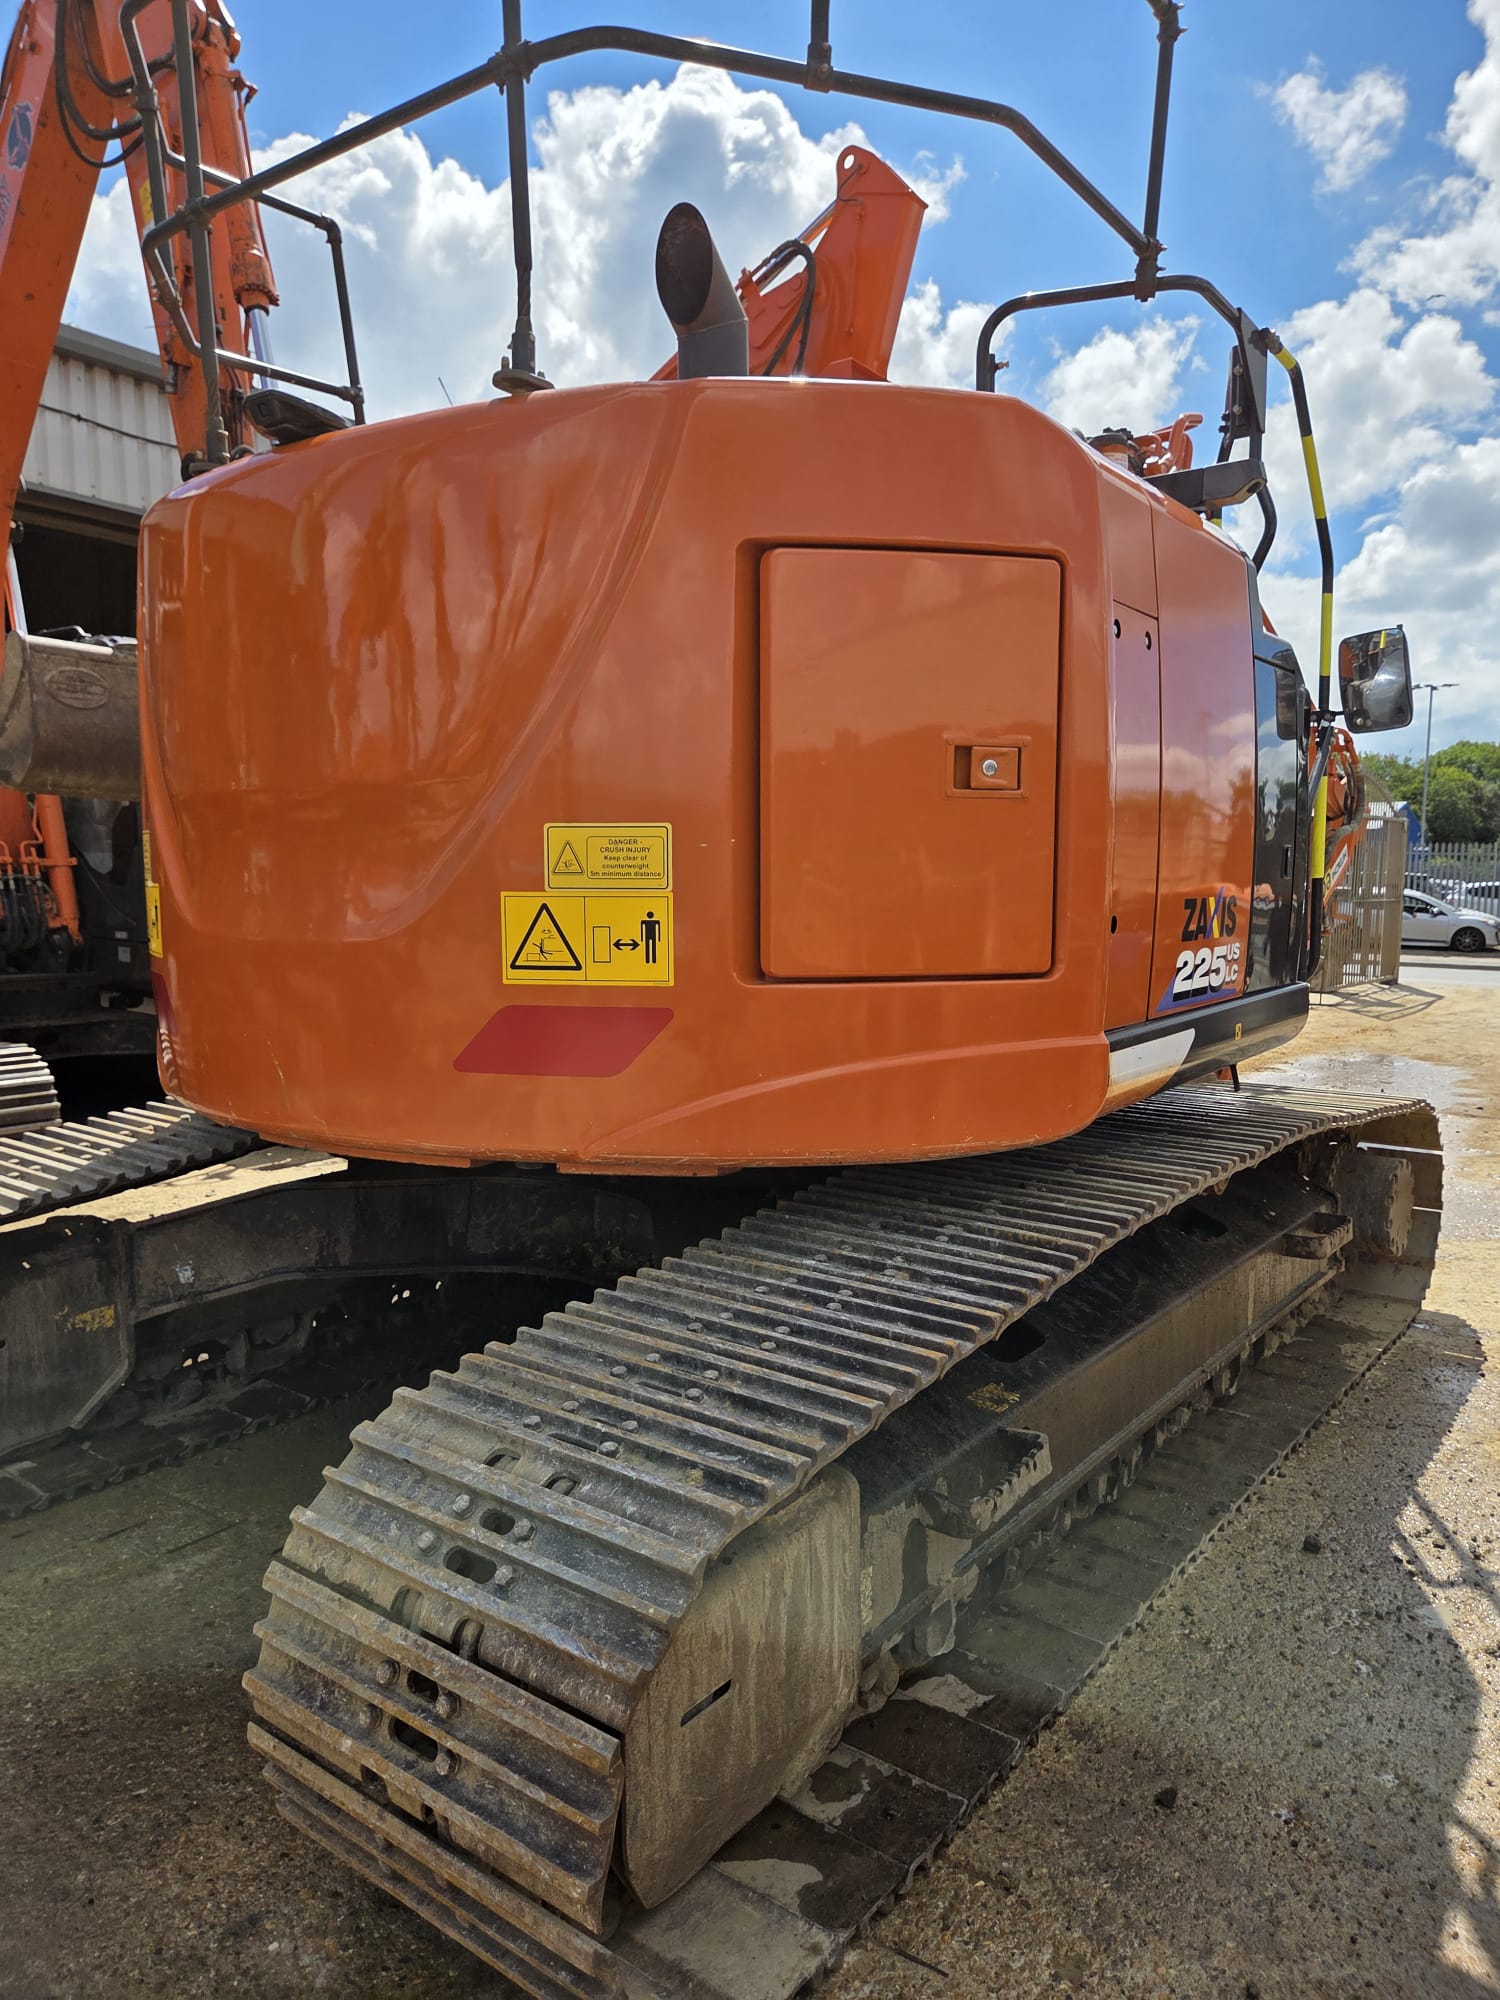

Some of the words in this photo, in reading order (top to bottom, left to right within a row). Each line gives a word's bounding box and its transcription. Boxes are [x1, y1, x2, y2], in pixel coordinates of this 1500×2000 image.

[1182, 887, 1237, 942] ZAXIS
[1173, 946, 1227, 999] 225
[1226, 942, 1240, 961] US
[1225, 964, 1238, 983] LC
